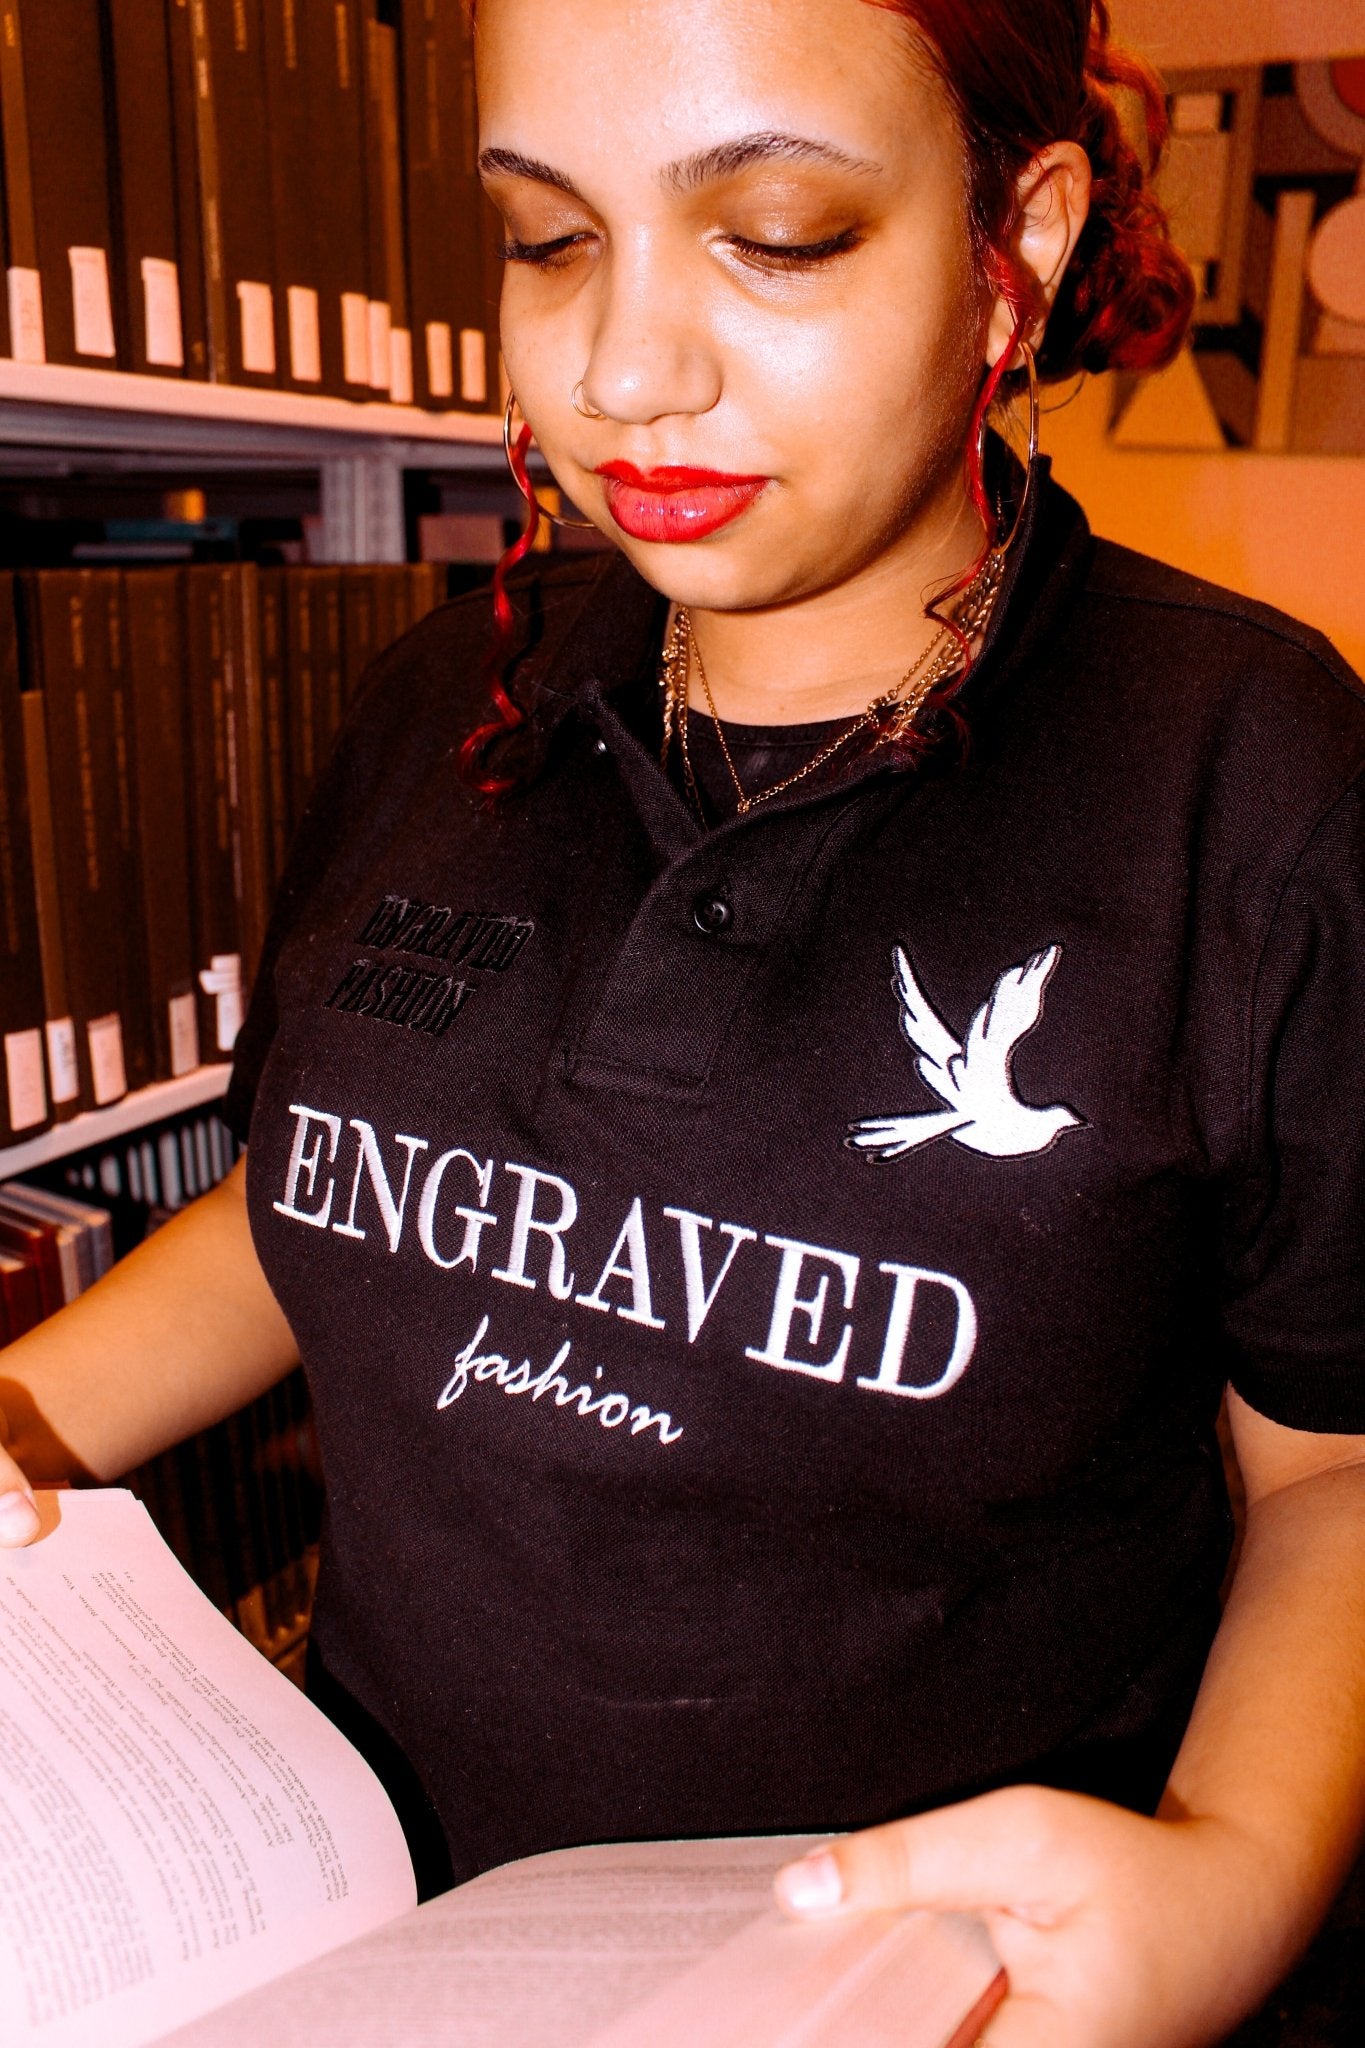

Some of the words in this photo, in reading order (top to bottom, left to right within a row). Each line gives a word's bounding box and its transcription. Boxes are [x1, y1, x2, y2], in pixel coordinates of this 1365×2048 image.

[357, 895, 535, 972] ENGRAVED
[323, 958, 477, 1037] FASHION
[273, 1105, 976, 1399] ENGRAVED
[437, 1315, 683, 1444] fashion
